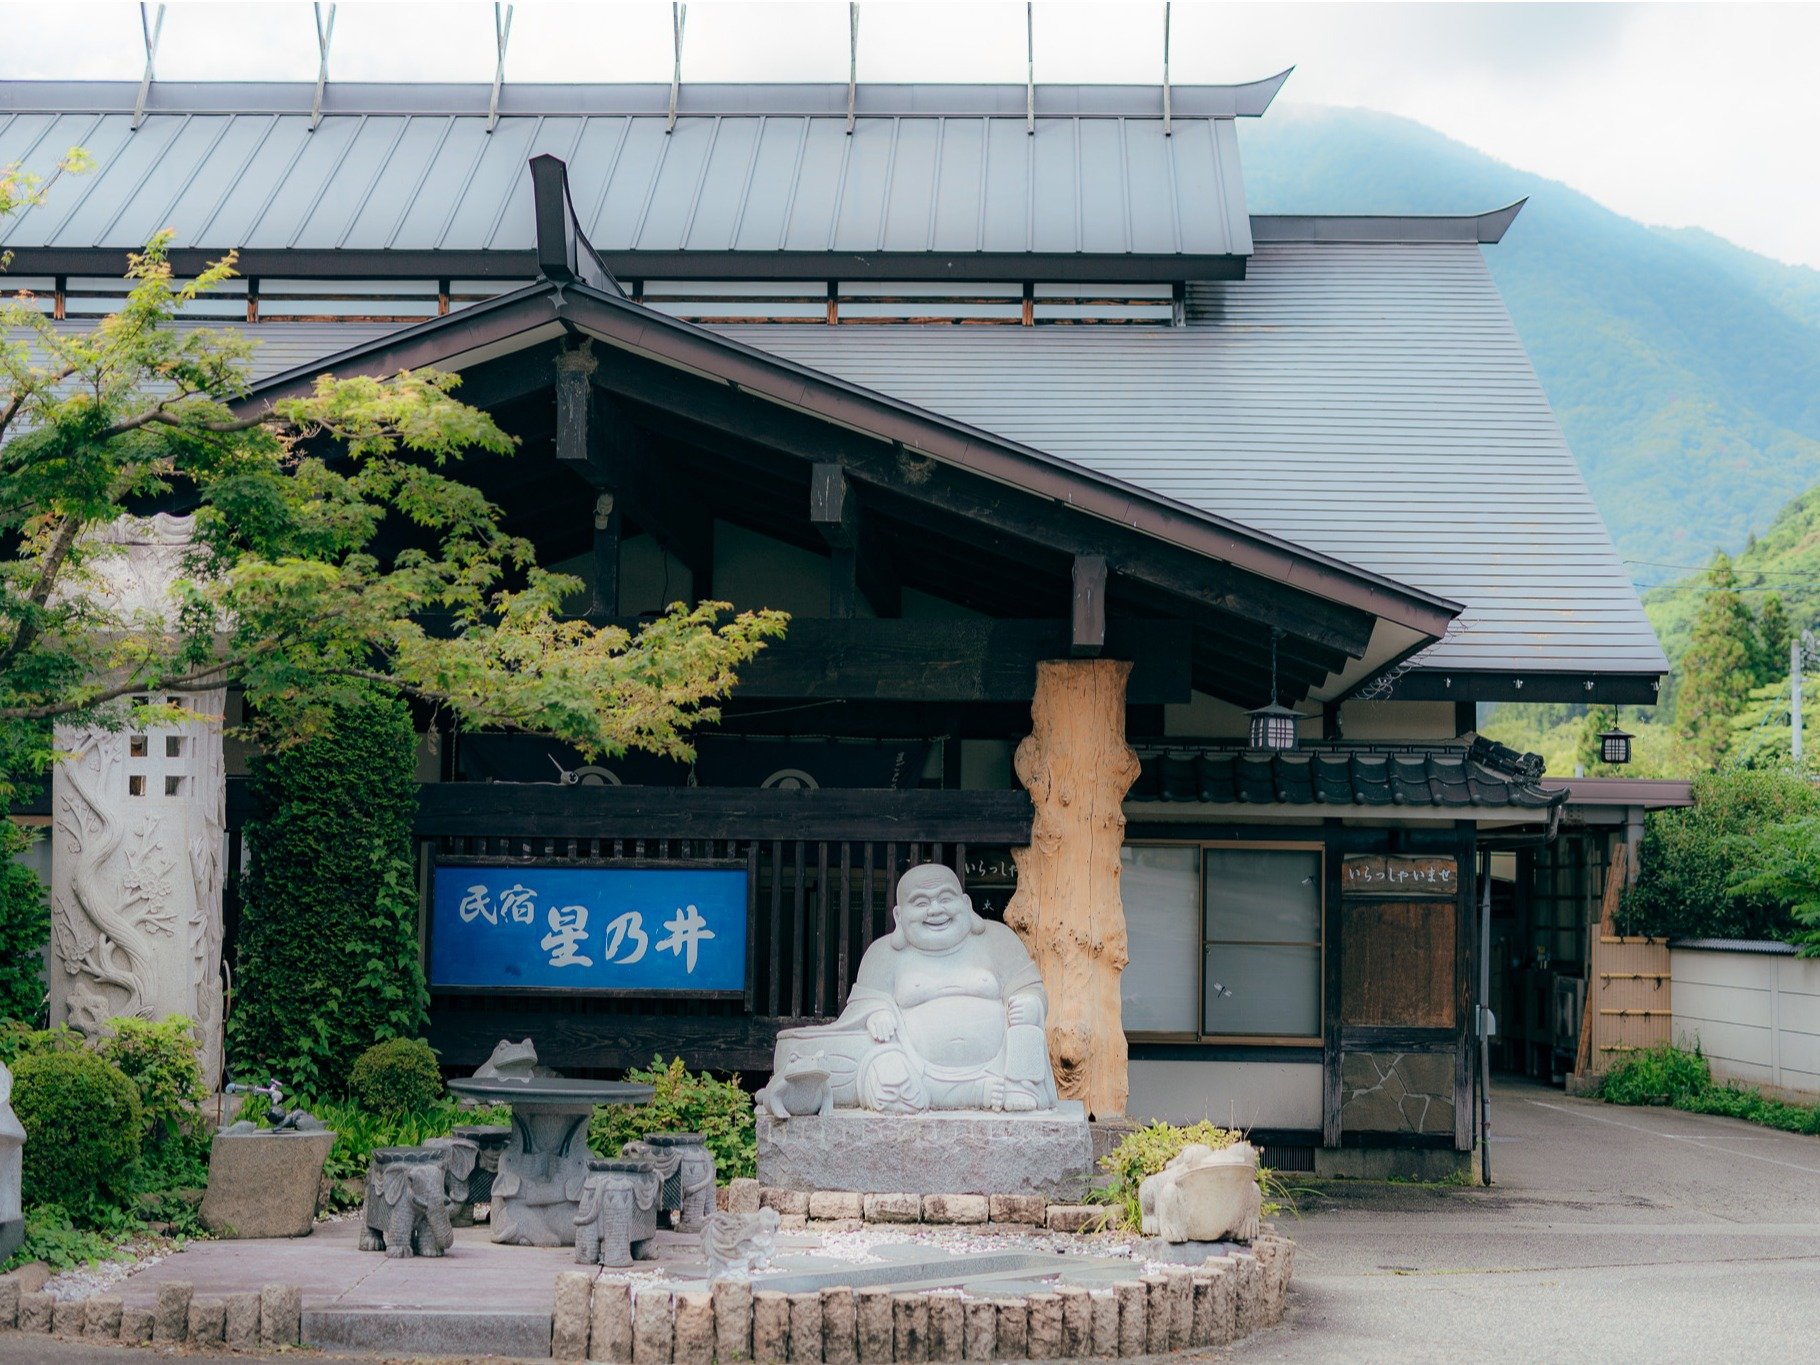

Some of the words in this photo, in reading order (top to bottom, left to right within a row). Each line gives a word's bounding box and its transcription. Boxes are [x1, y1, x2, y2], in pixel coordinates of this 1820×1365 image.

[1349, 865, 1451, 883] いらっしゃいませ
[459, 883, 538, 926] 民宿
[540, 904, 716, 975] 星乃井
